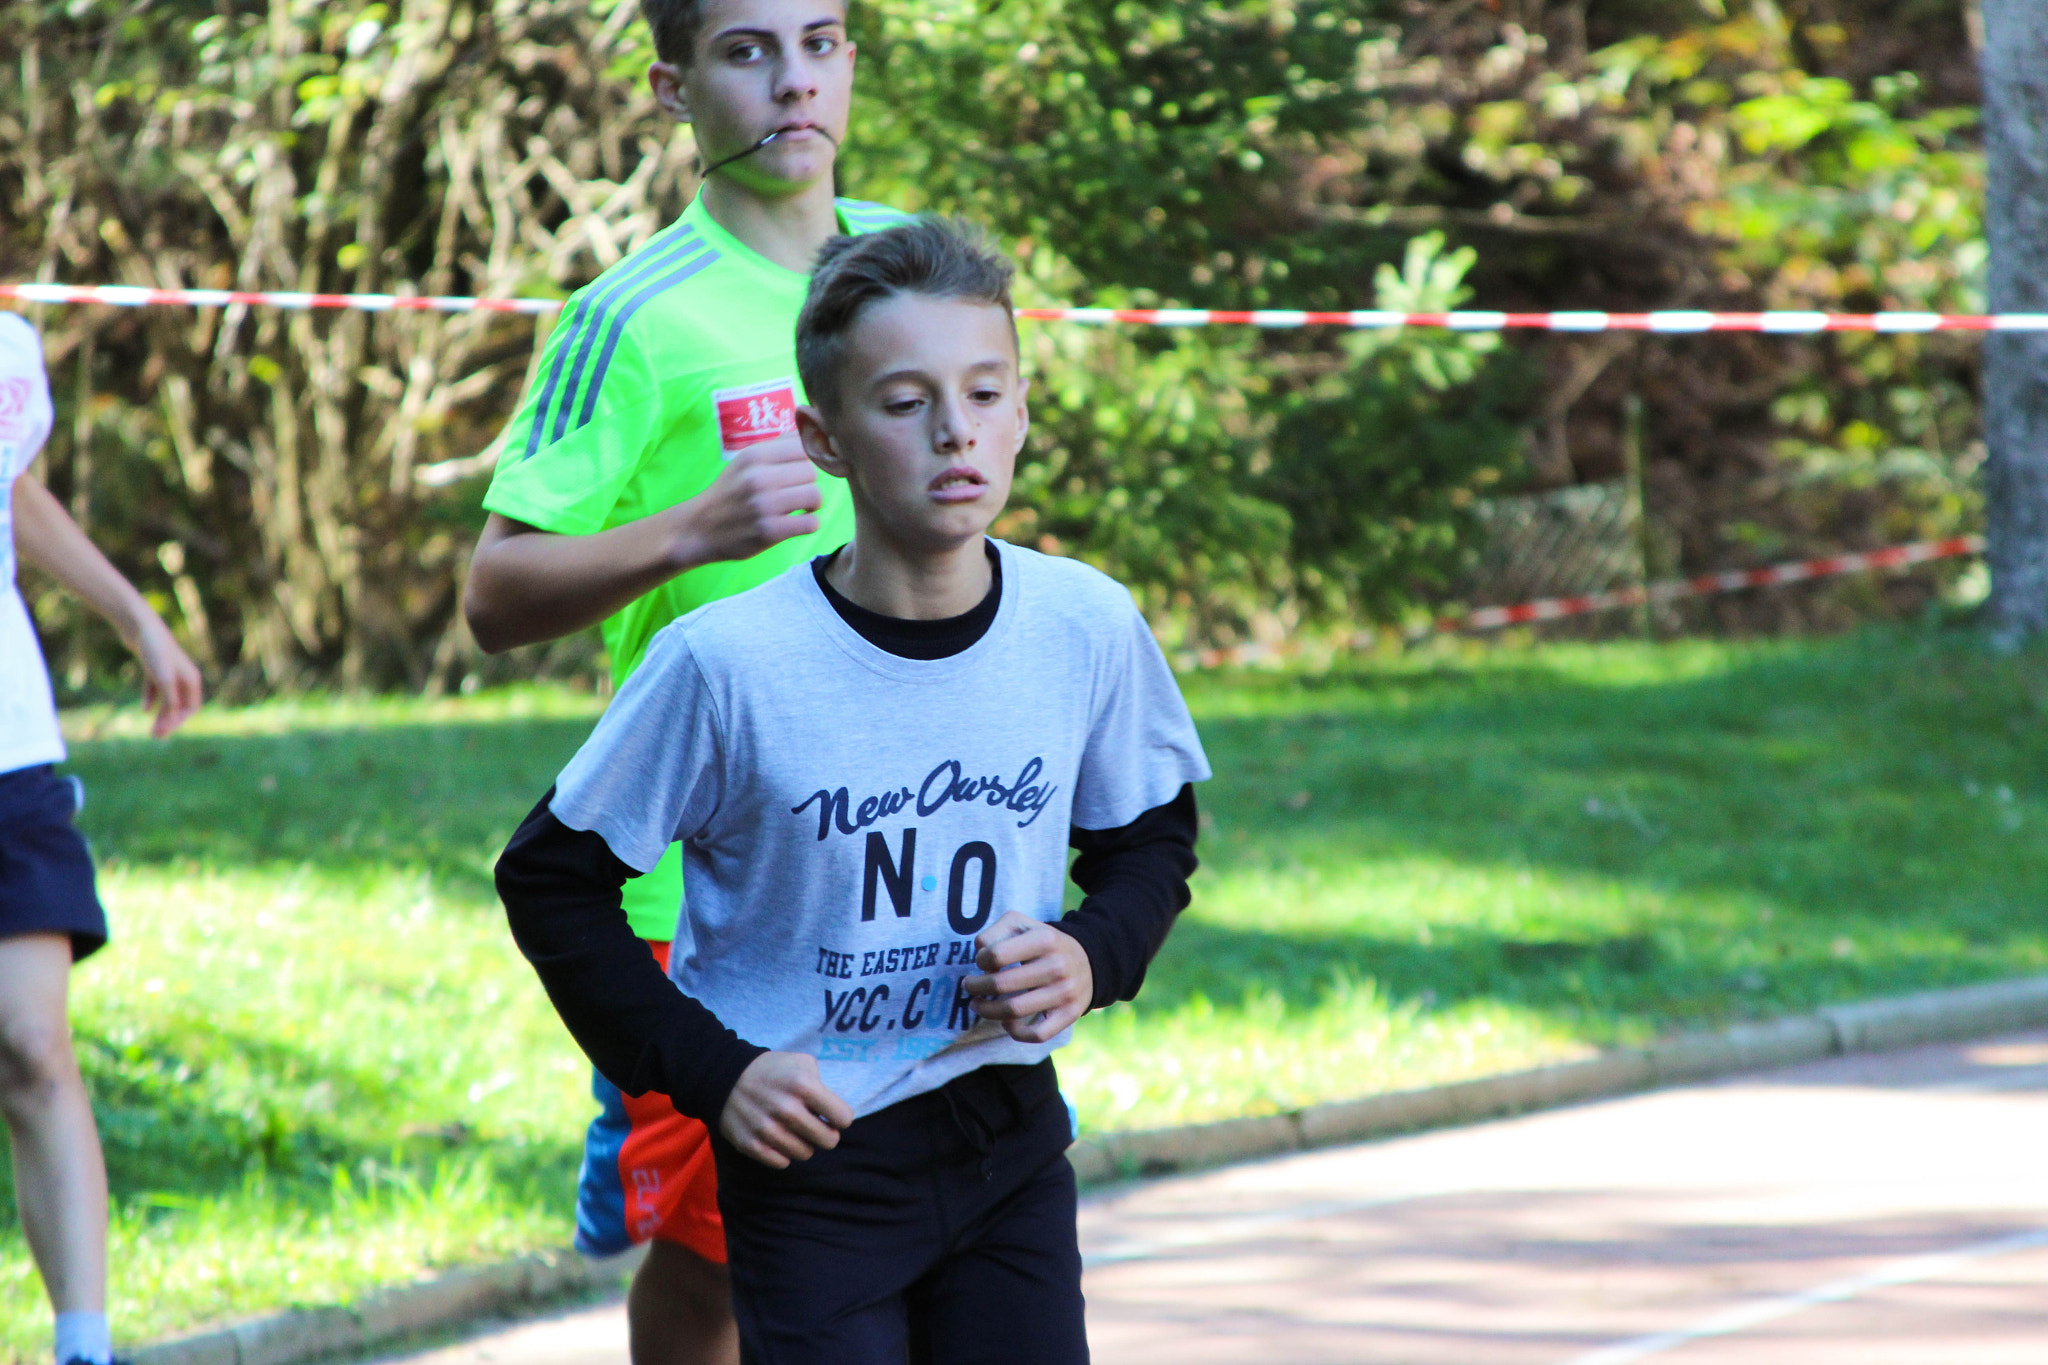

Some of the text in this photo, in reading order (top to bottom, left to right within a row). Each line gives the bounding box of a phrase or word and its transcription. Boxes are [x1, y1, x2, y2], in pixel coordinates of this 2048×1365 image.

[791, 756, 1058, 841] New Owsley
[816, 946, 855, 979] THE
[860, 942, 940, 977] EASTER
